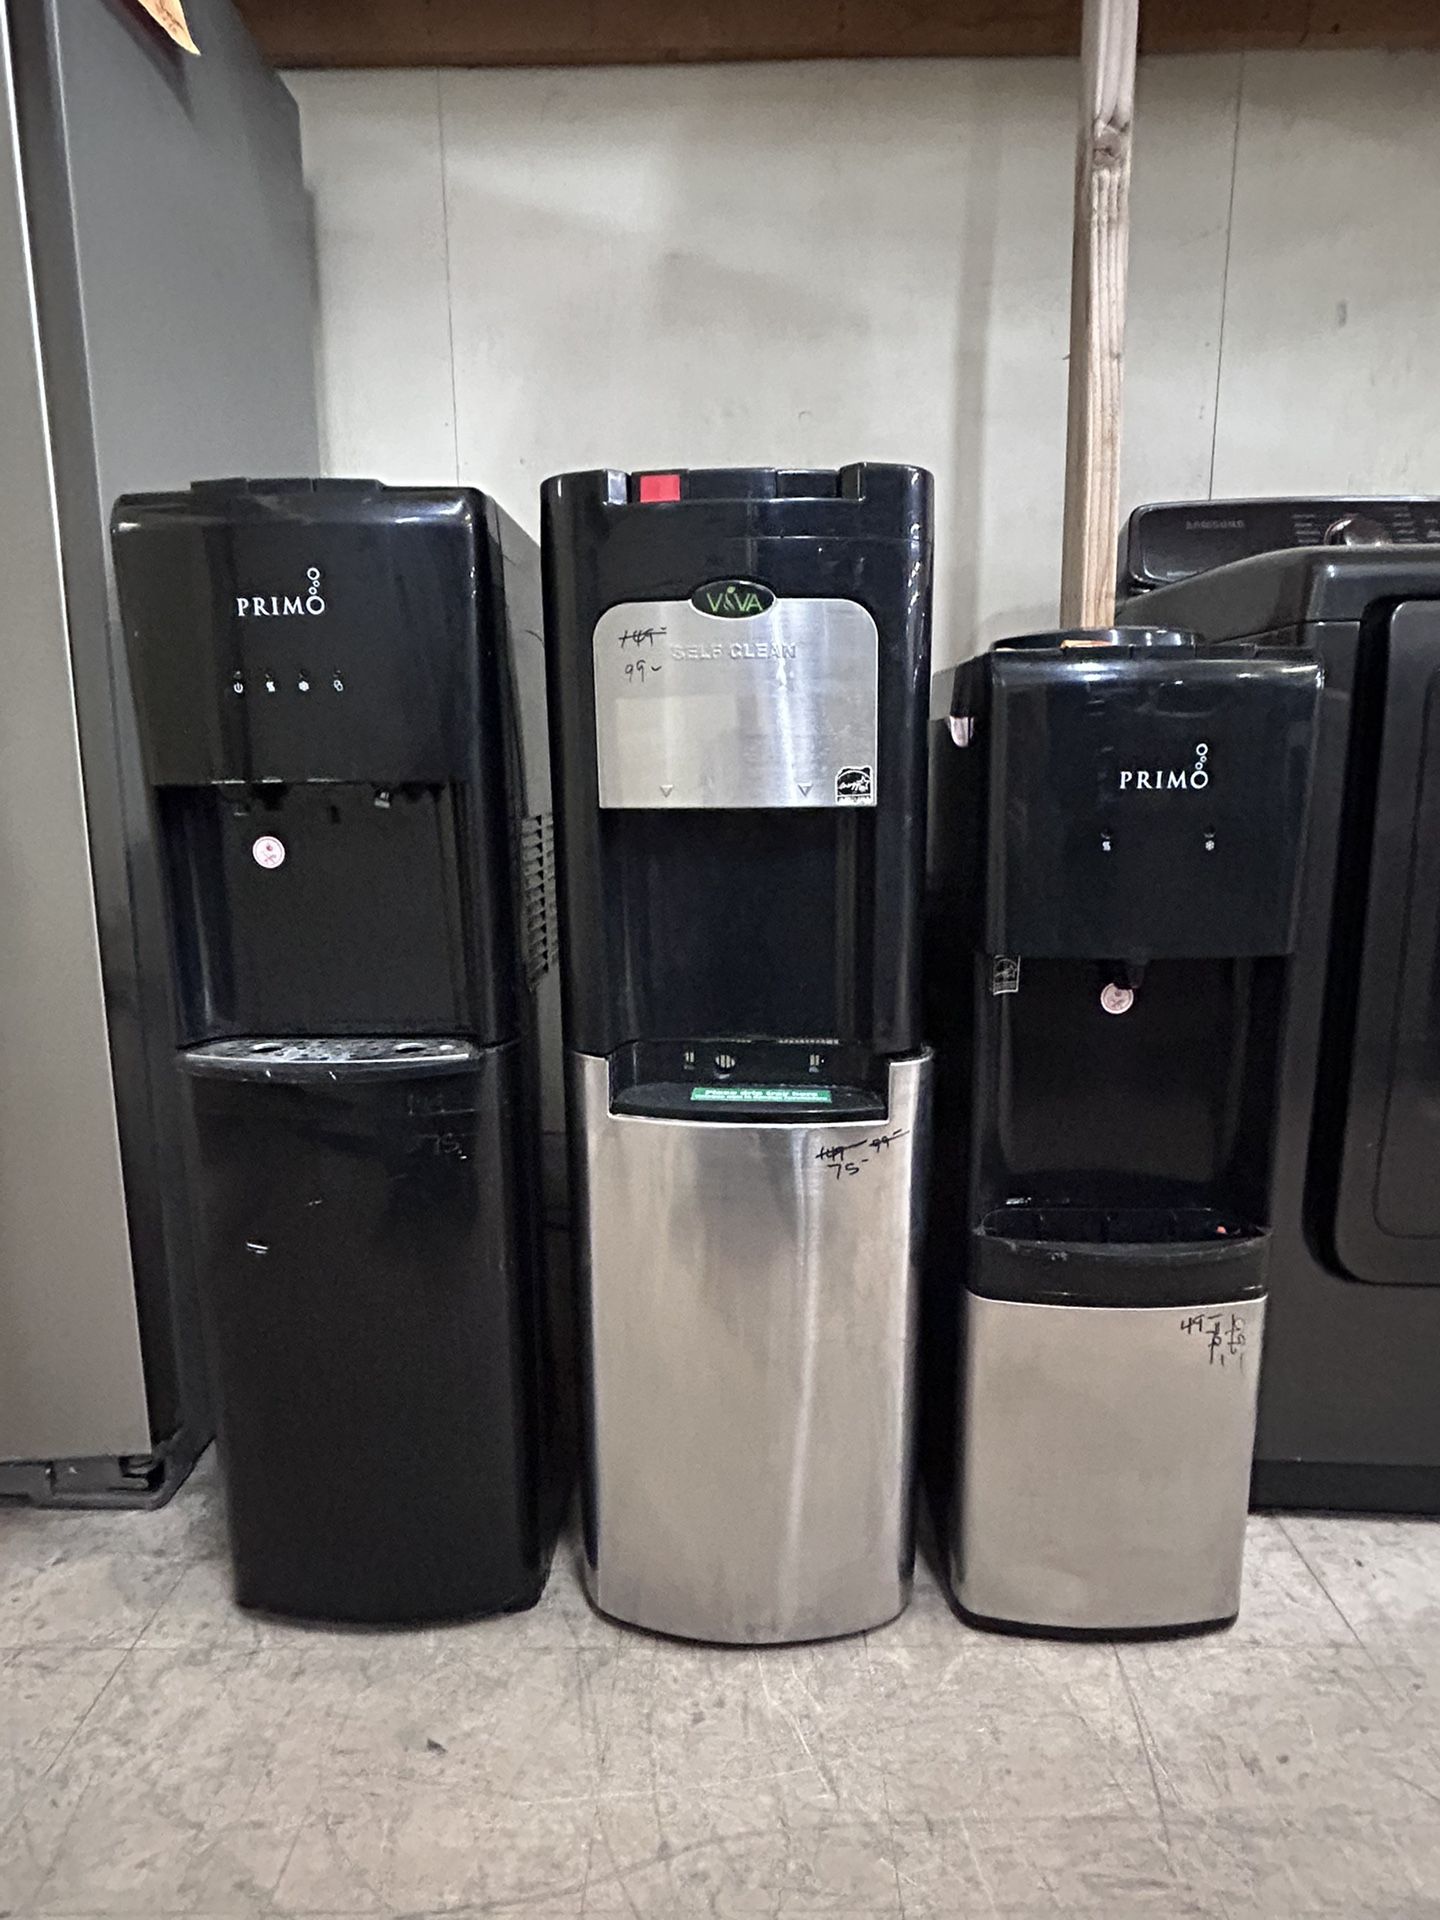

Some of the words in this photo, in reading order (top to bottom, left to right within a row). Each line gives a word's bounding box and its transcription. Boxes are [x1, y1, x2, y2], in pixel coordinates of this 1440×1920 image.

[236, 595, 326, 617] PRIMO
[706, 587, 764, 612] VIVA
[670, 642, 723, 661] SELF
[729, 641, 798, 660] CLEAN
[1119, 769, 1209, 790] PRIMO
